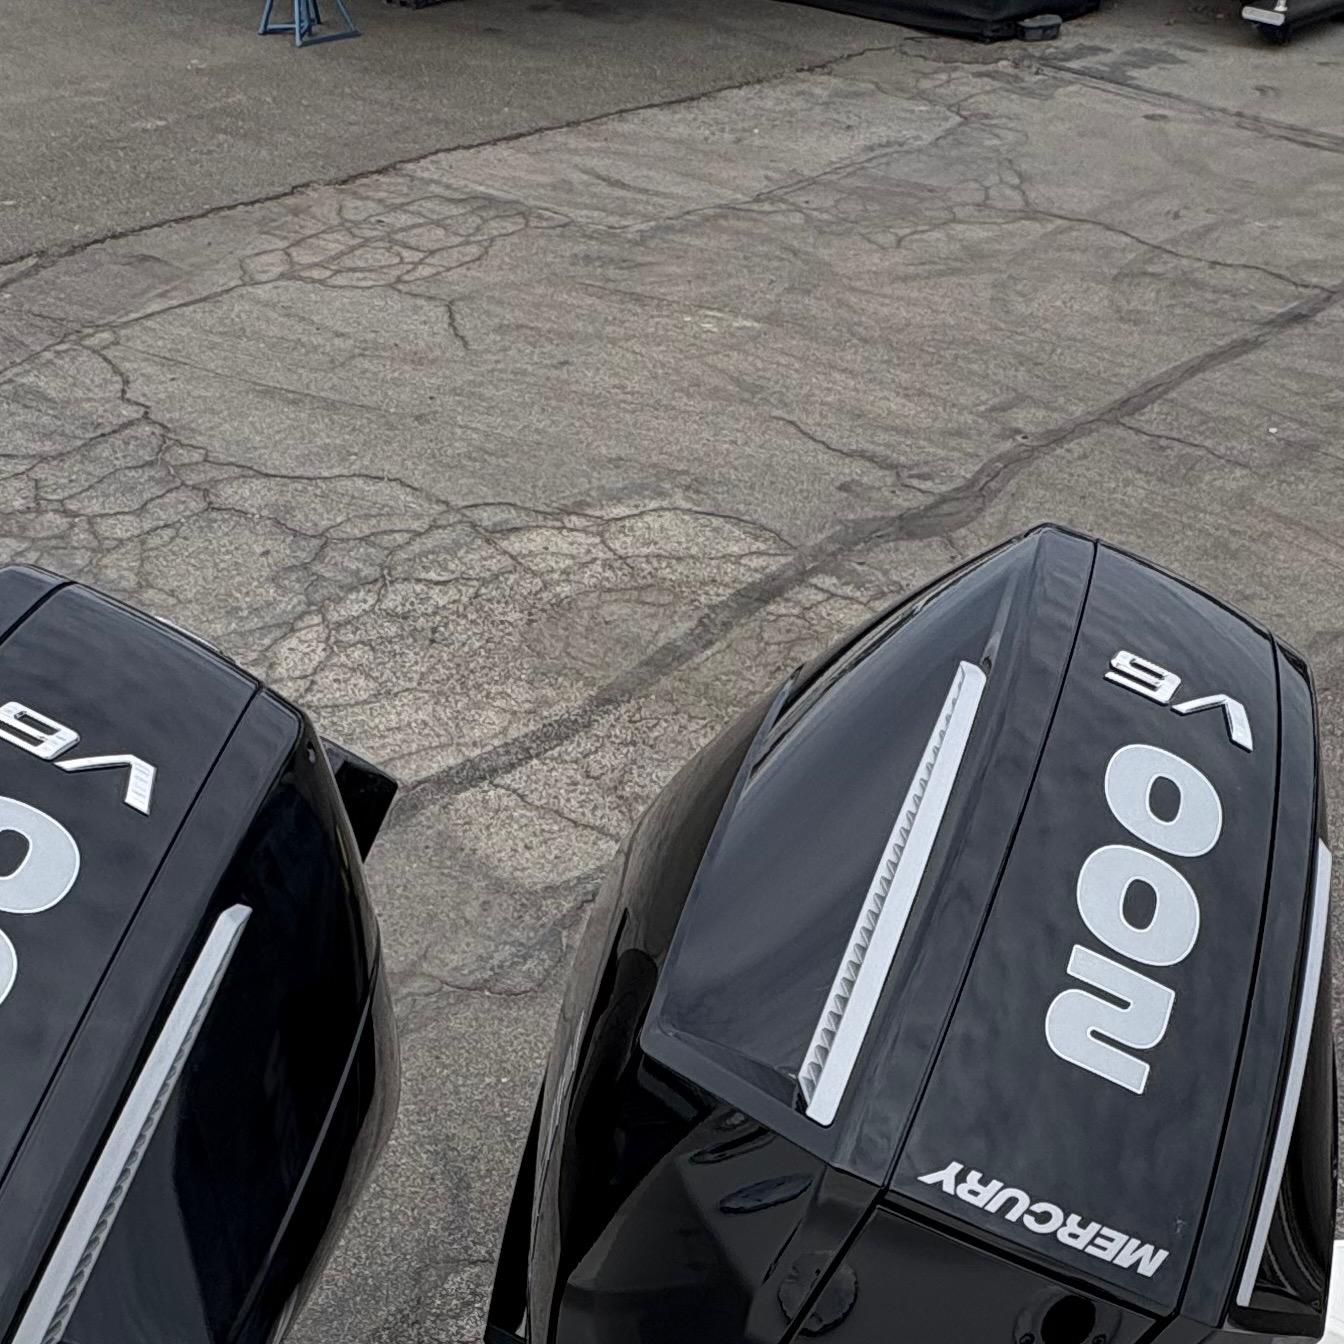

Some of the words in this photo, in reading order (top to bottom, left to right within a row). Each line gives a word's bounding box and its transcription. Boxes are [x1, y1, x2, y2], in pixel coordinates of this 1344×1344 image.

[1104, 649, 1254, 752] V6
[1045, 744, 1222, 1094] 200
[917, 1161, 1170, 1278] MERCURY
